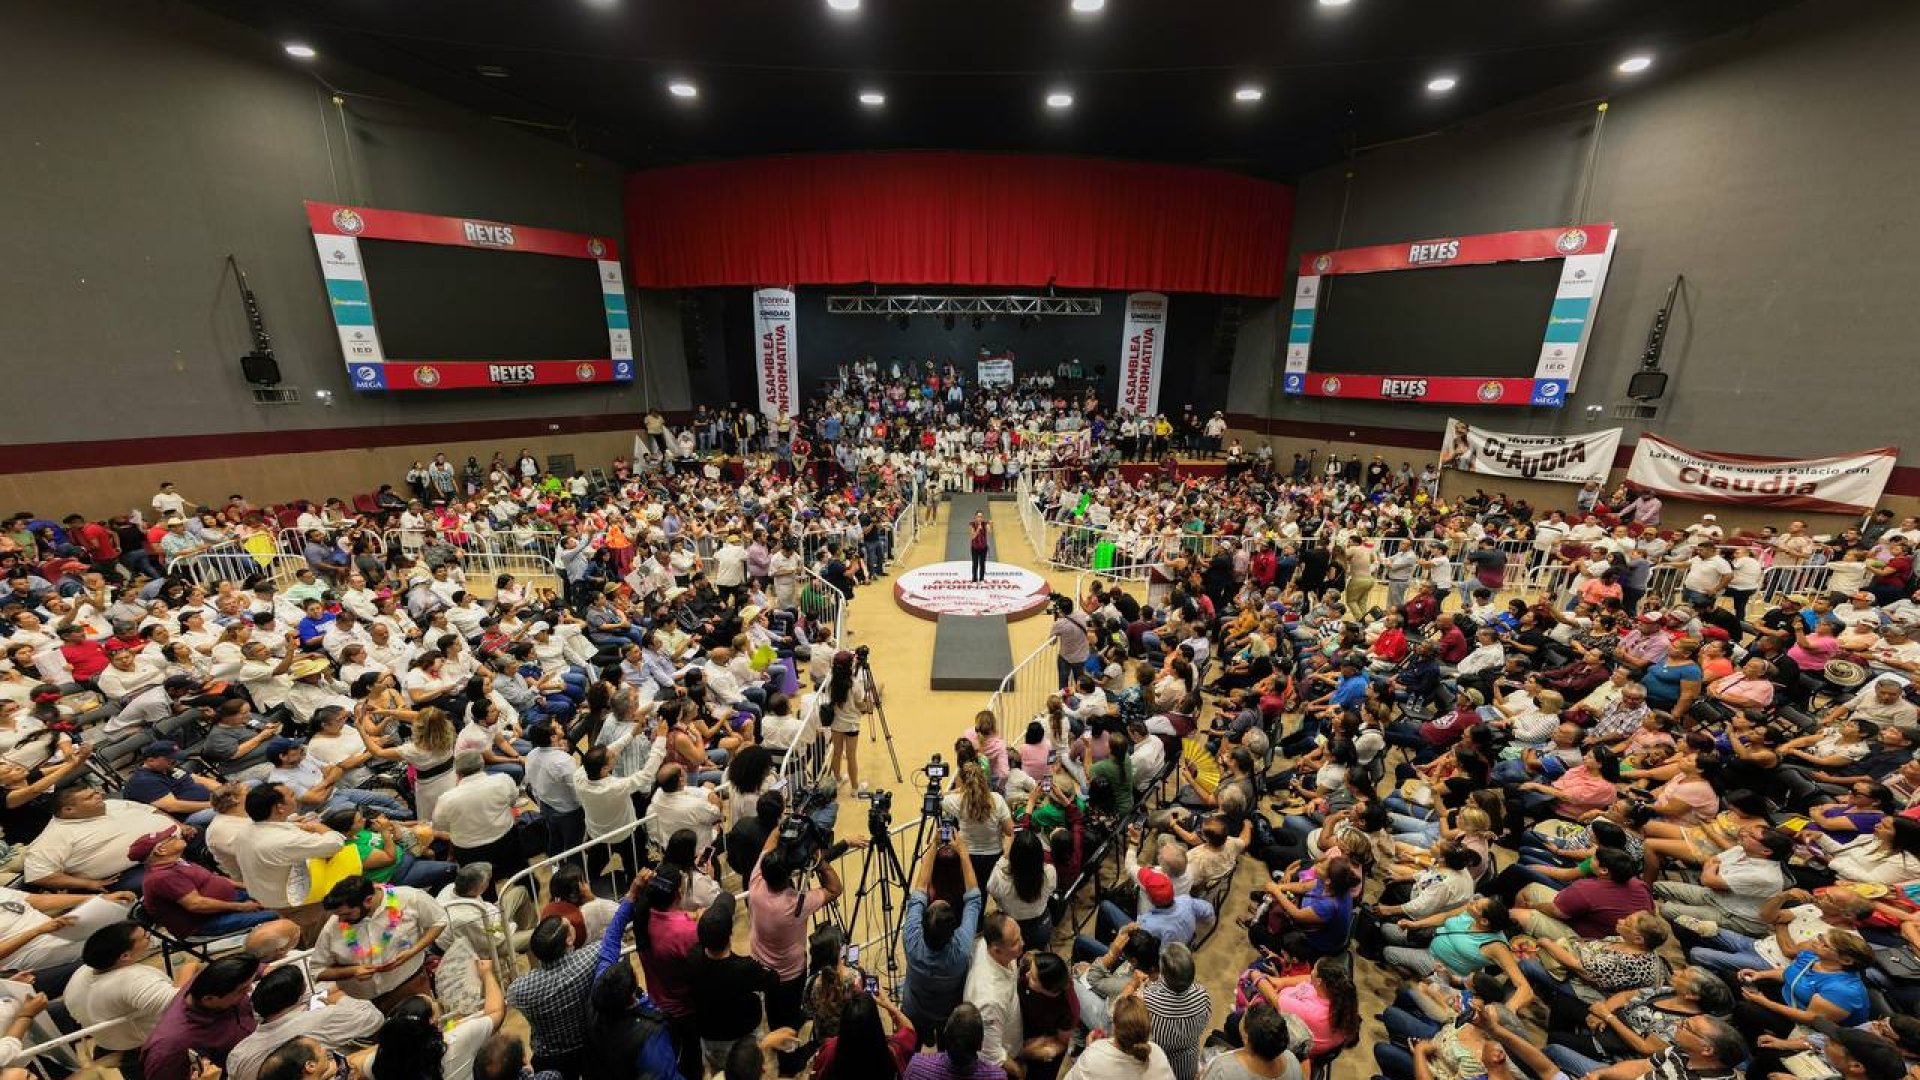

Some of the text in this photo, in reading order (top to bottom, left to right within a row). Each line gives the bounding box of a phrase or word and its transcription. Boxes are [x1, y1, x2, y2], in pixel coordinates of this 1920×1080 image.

[464, 221, 514, 246] REYES
[1409, 240, 1459, 262] REYES
[489, 364, 535, 382] REYES
[763, 332, 777, 404] ASAMBLEA
[775, 323, 790, 412] INFORMATIVA
[1125, 335, 1141, 405] ASAMBLEA
[1137, 327, 1155, 413] INFORMATIVA
[356, 380, 383, 389] MEGA
[1381, 379, 1428, 397] REYES
[1535, 397, 1561, 406] MEGA
[1482, 437, 1585, 478] CLAUDIA
[1679, 466, 1818, 495] Claudia
[1788, 467, 1840, 475] Palacio
